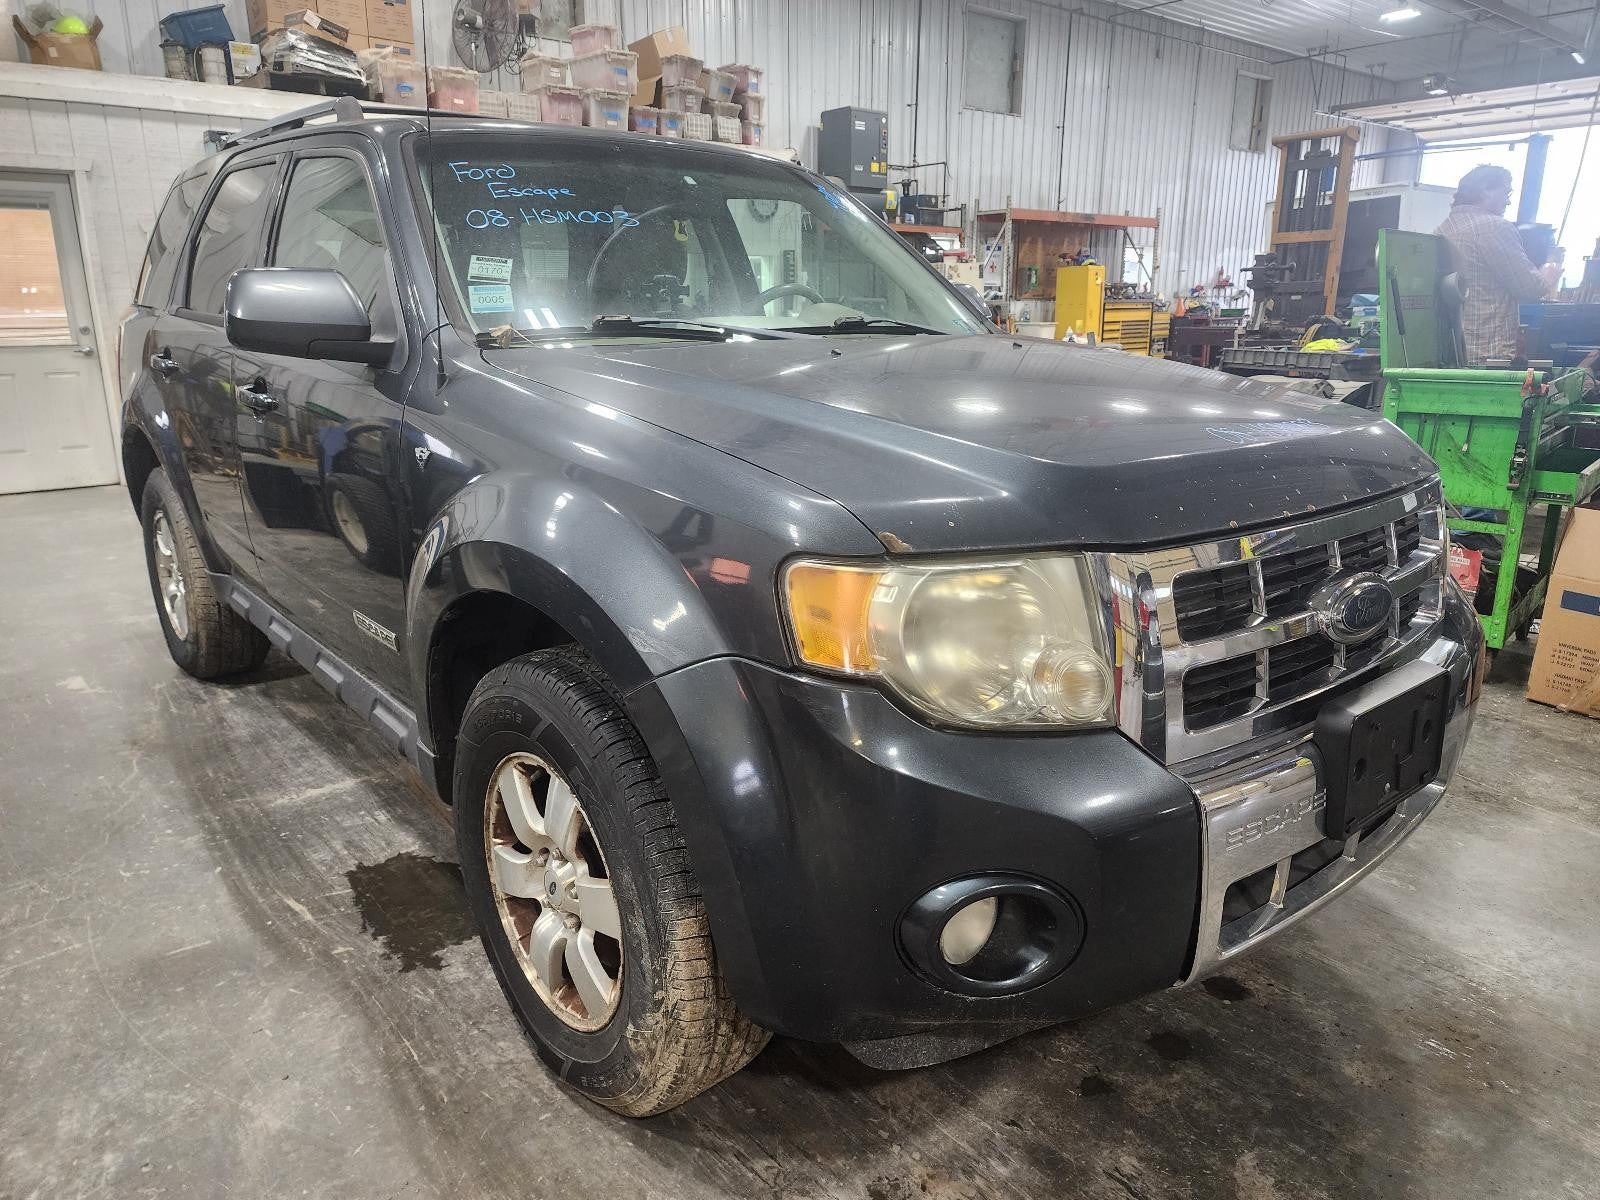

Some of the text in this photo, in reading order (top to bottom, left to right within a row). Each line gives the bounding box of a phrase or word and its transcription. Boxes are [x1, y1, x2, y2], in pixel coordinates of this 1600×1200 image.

[449, 161, 516, 183] Ford
[487, 181, 577, 200] Escape
[478, 295, 505, 304] 0005
[1226, 788, 1327, 852] ESCAPE
